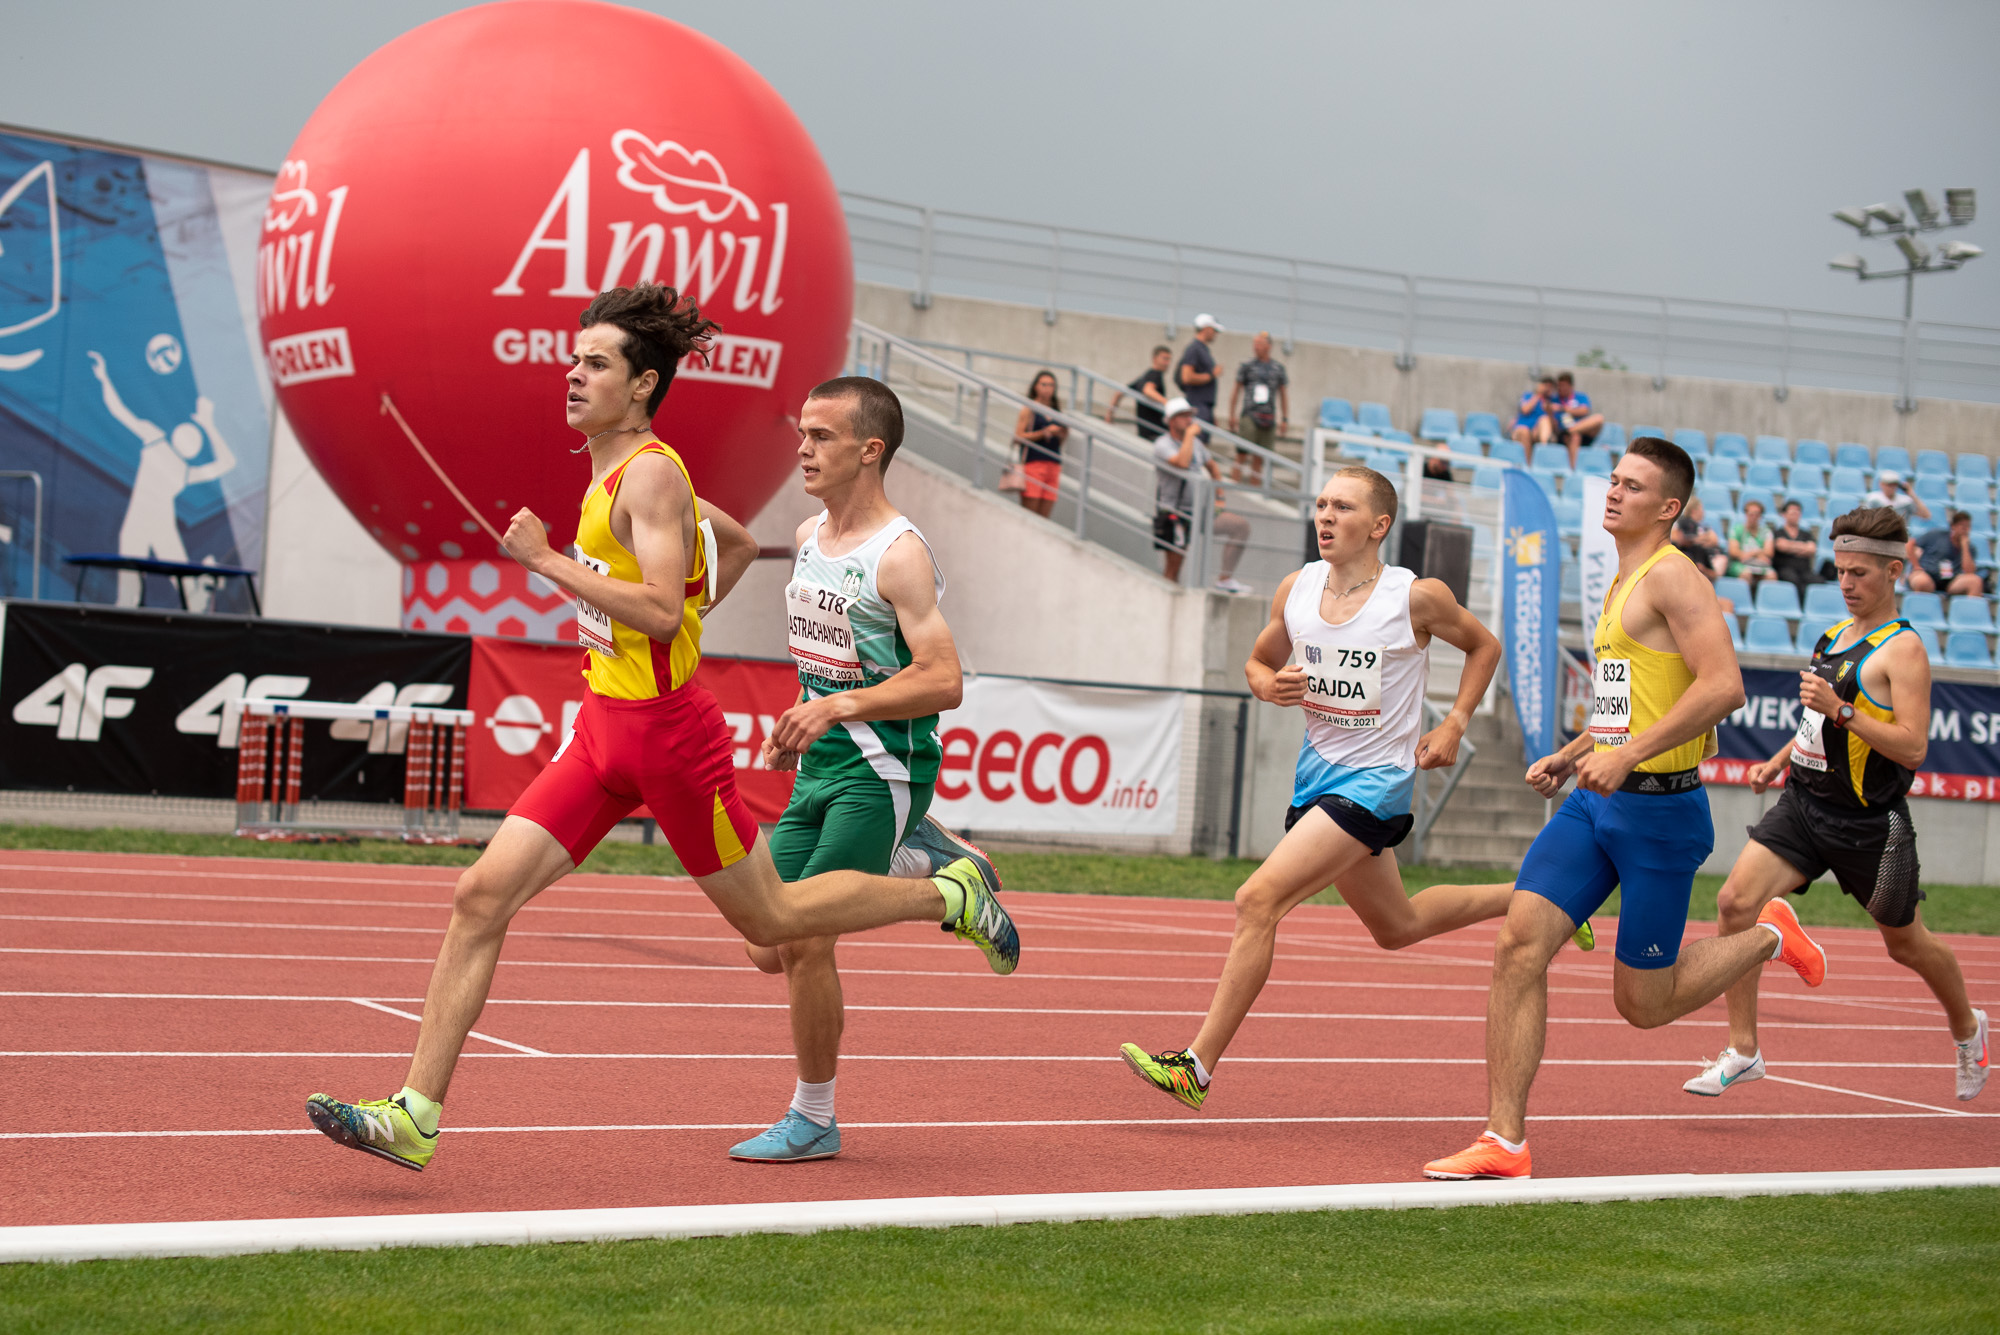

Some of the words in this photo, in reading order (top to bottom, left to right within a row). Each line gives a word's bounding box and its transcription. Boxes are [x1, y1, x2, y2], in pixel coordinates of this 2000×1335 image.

[492, 147, 788, 315] Anwil
[493, 328, 579, 365] GRU
[685, 341, 773, 379] RLEN
[818, 589, 847, 616] 278
[789, 615, 851, 650] ASTRACHANCEW
[1338, 649, 1377, 669] 759
[1603, 663, 1625, 682] 832
[798, 671, 864, 690] ARSZAWA
[835, 669, 858, 680] 2021
[1307, 676, 1366, 700] GAJDA
[13, 663, 154, 741] 4F
[175, 672, 311, 748] 4F
[1595, 696, 1628, 716] BOWSKI
[329, 682, 455, 754] 4F
[1354, 717, 1376, 727] 2021
[1720, 694, 1800, 732] WEK
[1928, 708, 1962, 742] M
[1799, 717, 1816, 744] TOSIK
[1609, 736, 1628, 746] 2021
[933, 727, 1158, 810] eeco.info
[1806, 758, 1823, 768] 2021
[1668, 769, 1700, 790] TEC
[1908, 771, 1996, 801] ek.pl
